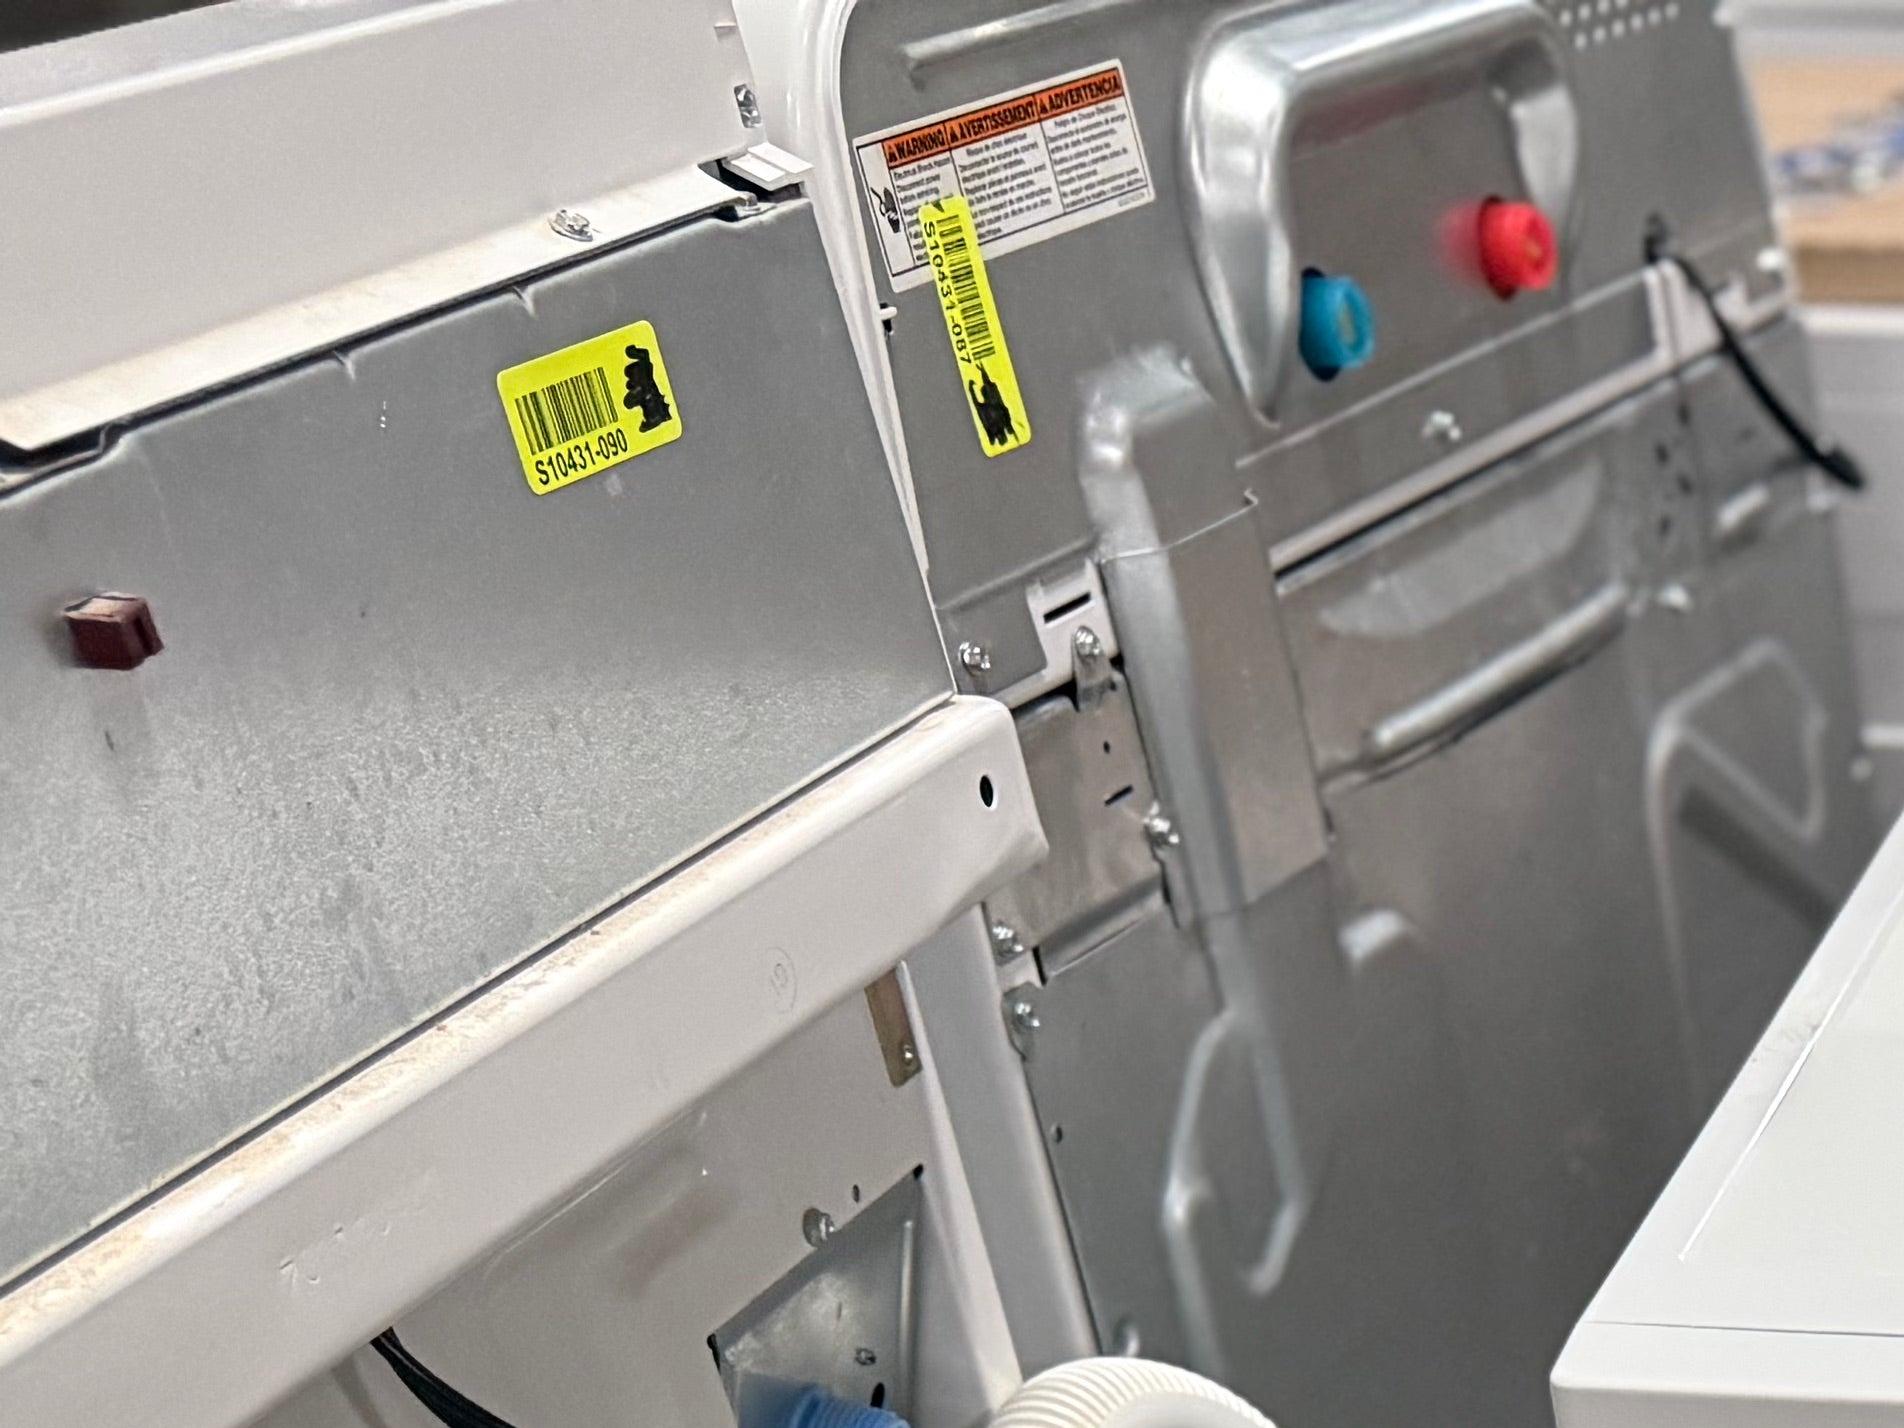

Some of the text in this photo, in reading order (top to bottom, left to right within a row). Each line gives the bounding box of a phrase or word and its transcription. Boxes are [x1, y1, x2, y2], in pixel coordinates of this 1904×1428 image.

[1048, 75, 1120, 111] ADVERTENCIA
[958, 100, 1034, 139] AVERTISSEMENT
[894, 128, 945, 159] WARNING
[924, 221, 972, 364] S10431-087
[535, 428, 628, 486] S10431-090
